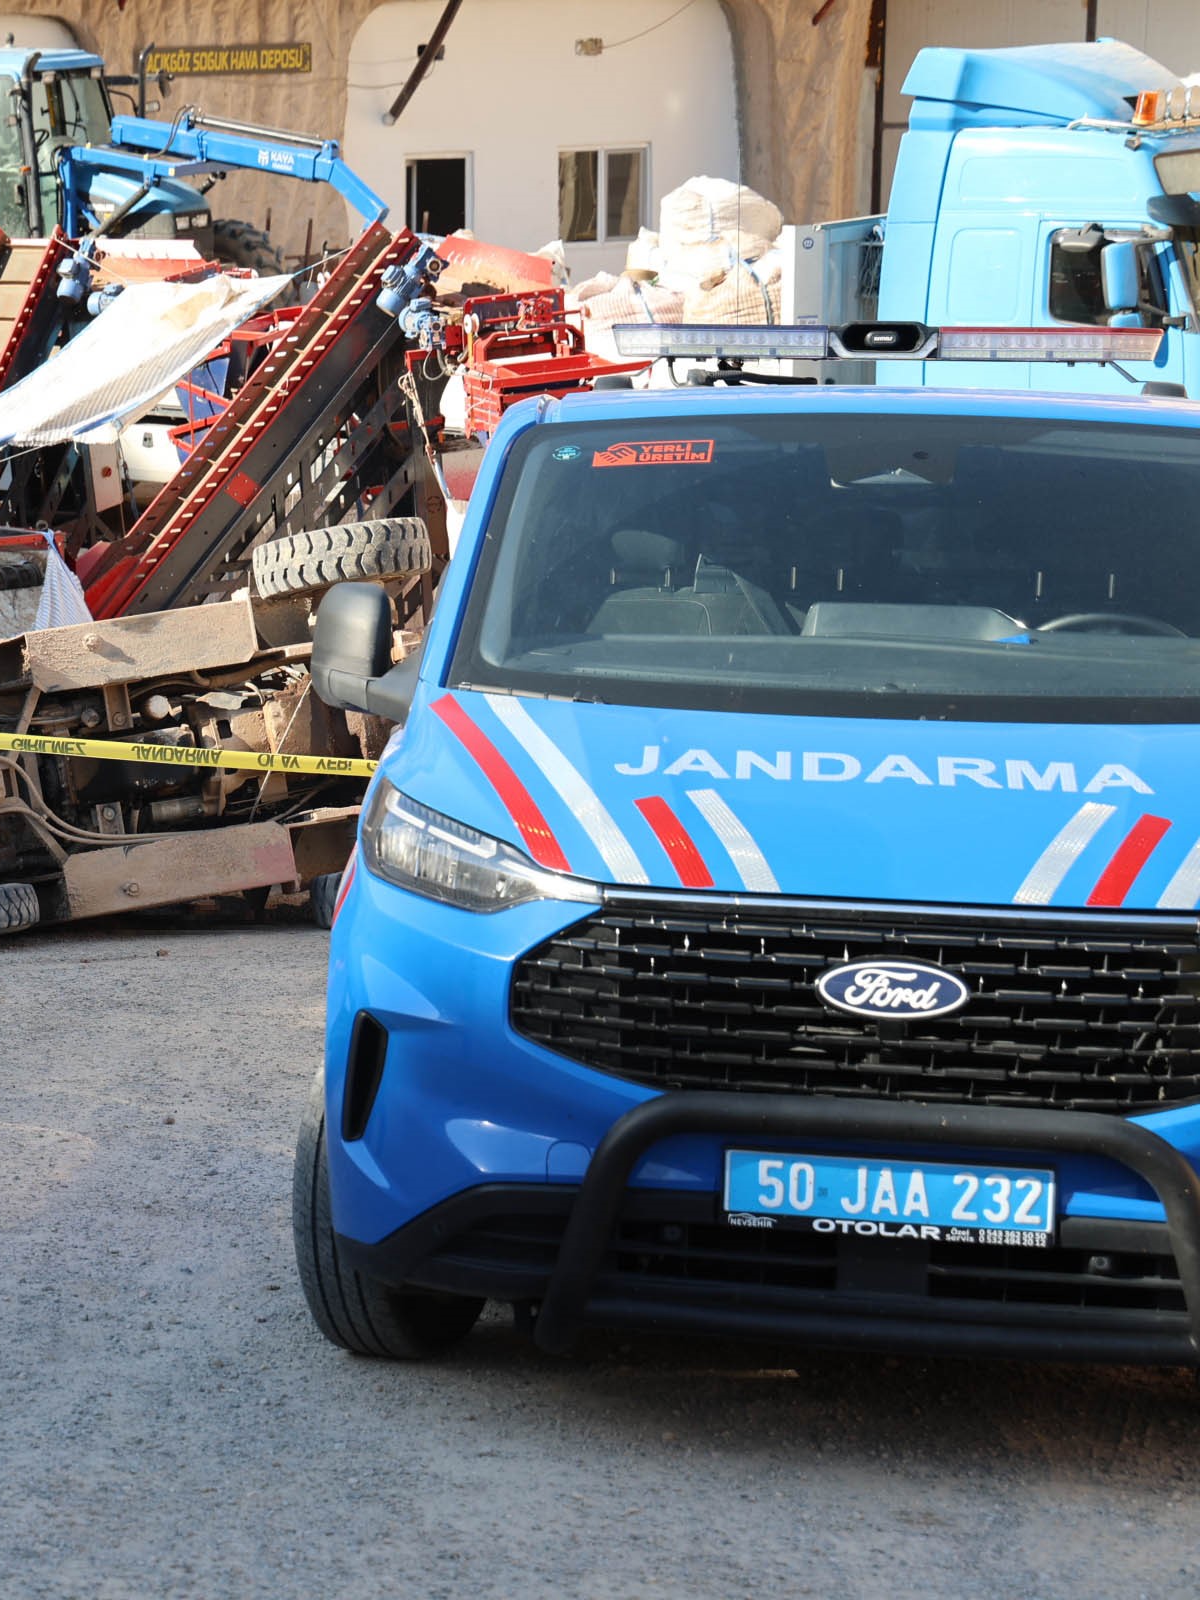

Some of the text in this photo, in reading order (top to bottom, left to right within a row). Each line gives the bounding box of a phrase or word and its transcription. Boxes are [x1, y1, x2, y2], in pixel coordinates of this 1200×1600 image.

[230, 50, 259, 71] HAVA
[260, 48, 303, 69] DEPOSU
[614, 745, 1156, 795] JANDARMA
[844, 968, 941, 1010] Ford
[758, 1159, 1043, 1225] 50 JAA 232
[812, 1218, 941, 1241] OTOLAR
